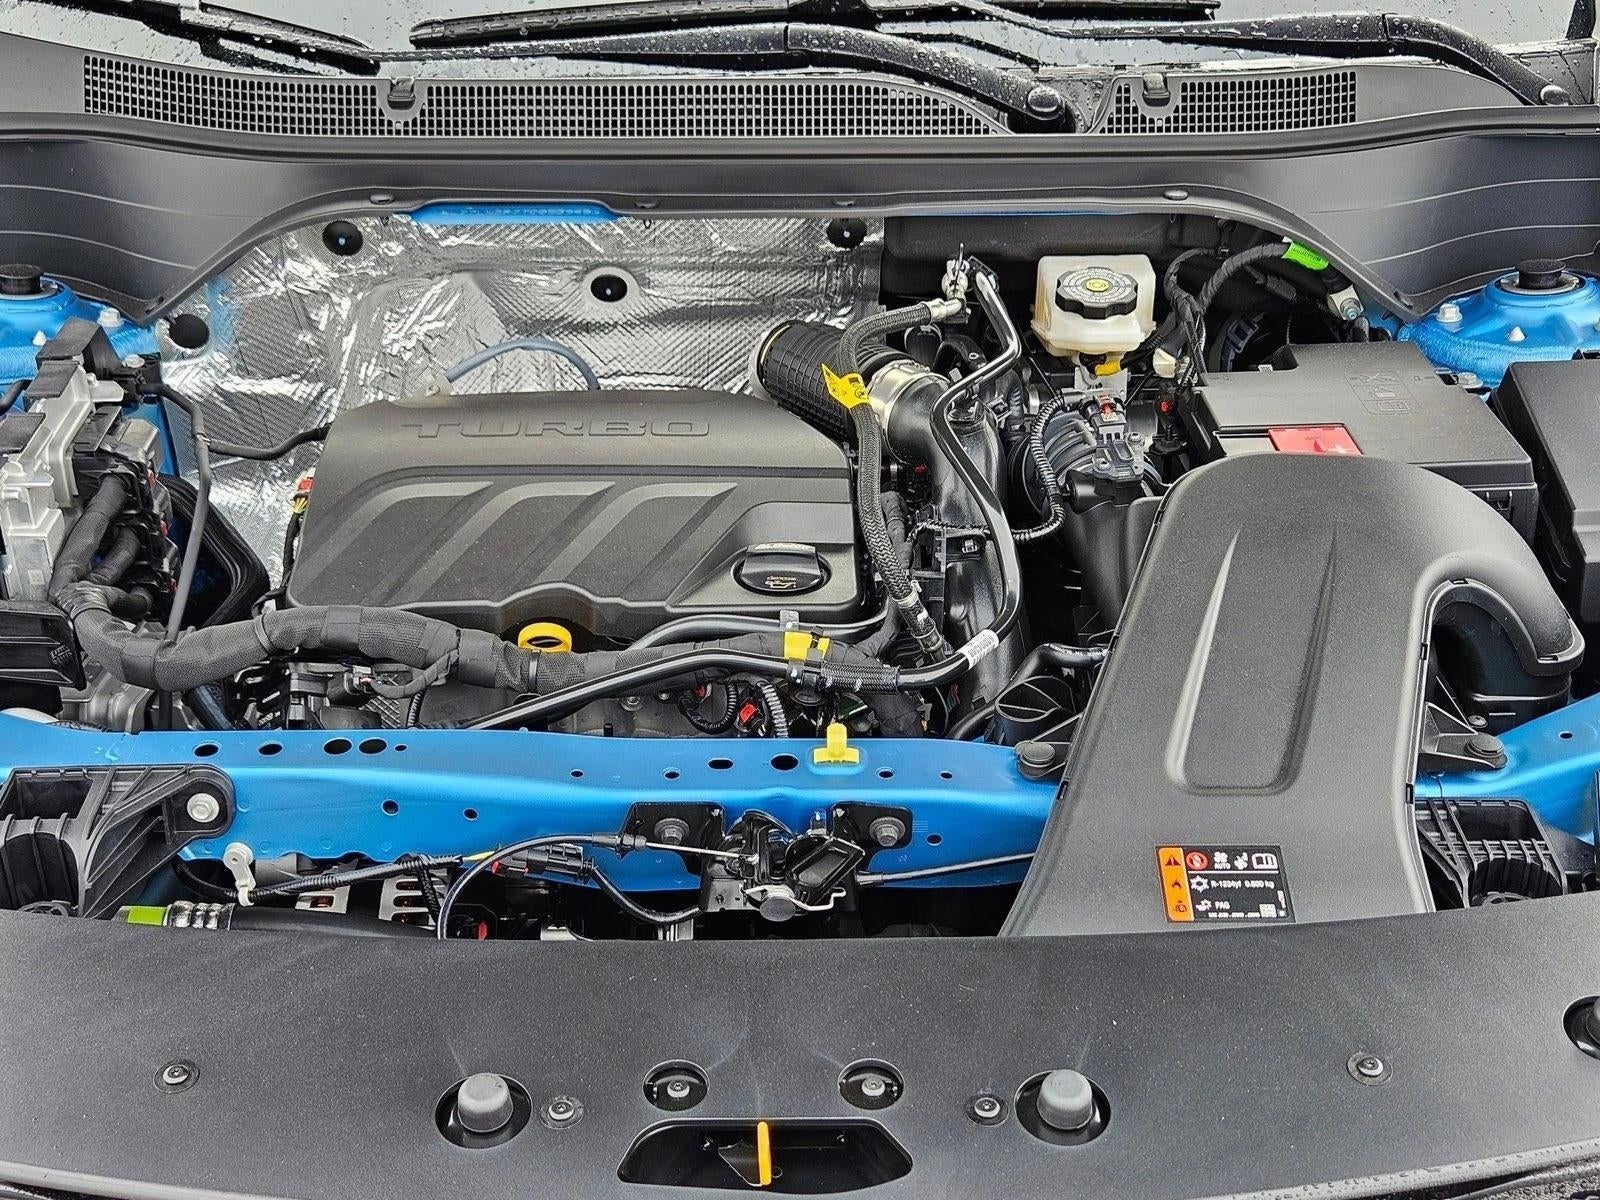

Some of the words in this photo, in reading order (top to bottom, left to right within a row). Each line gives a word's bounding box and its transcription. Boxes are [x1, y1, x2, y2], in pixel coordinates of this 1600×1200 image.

[401, 420, 710, 438] TURBO
[1214, 862, 1231, 870] AUTO
[1264, 880, 1275, 889] kg
[1215, 901, 1230, 909] PAG
